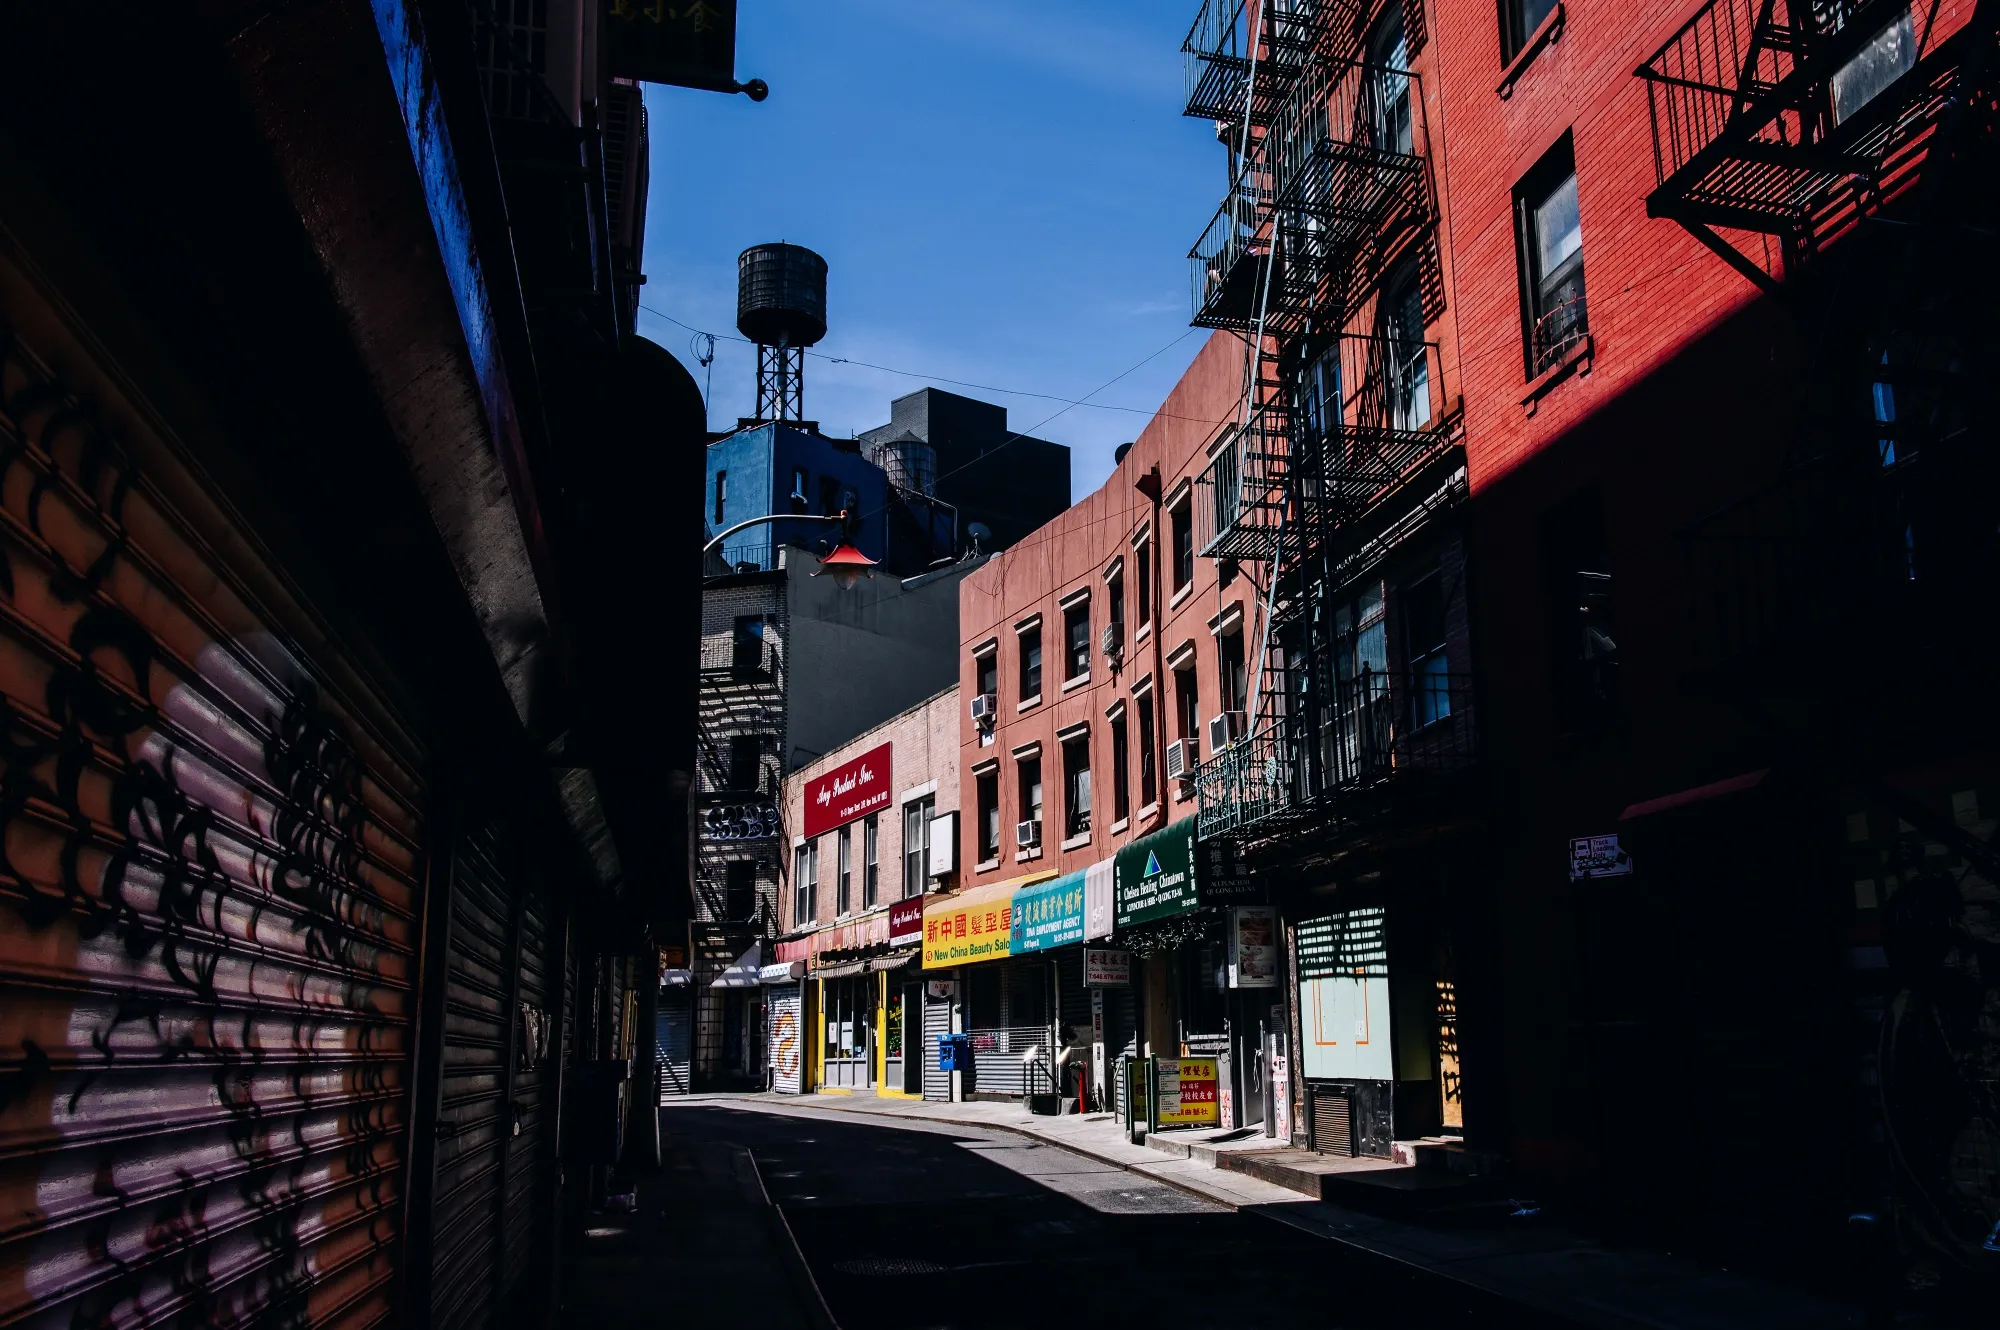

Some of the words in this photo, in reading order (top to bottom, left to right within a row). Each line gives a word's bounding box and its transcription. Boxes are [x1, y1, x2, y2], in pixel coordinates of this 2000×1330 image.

[816, 784, 831, 807] Any
[832, 771, 857, 798] Product
[858, 763, 875, 786] Inc.
[1123, 885, 1139, 901] Chelsea
[1140, 879, 1158, 895] Healing
[1159, 871, 1185, 889] Chinatown
[1036, 920, 1062, 937] EMPLOYMENT
[1062, 915, 1081, 930] AGENCY
[934, 950, 948, 961] New
[950, 946, 968, 959] China
[969, 941, 993, 956] Beauty
[994, 938, 1011, 951] Salo
[1179, 1065, 1209, 1077] 理髮店
